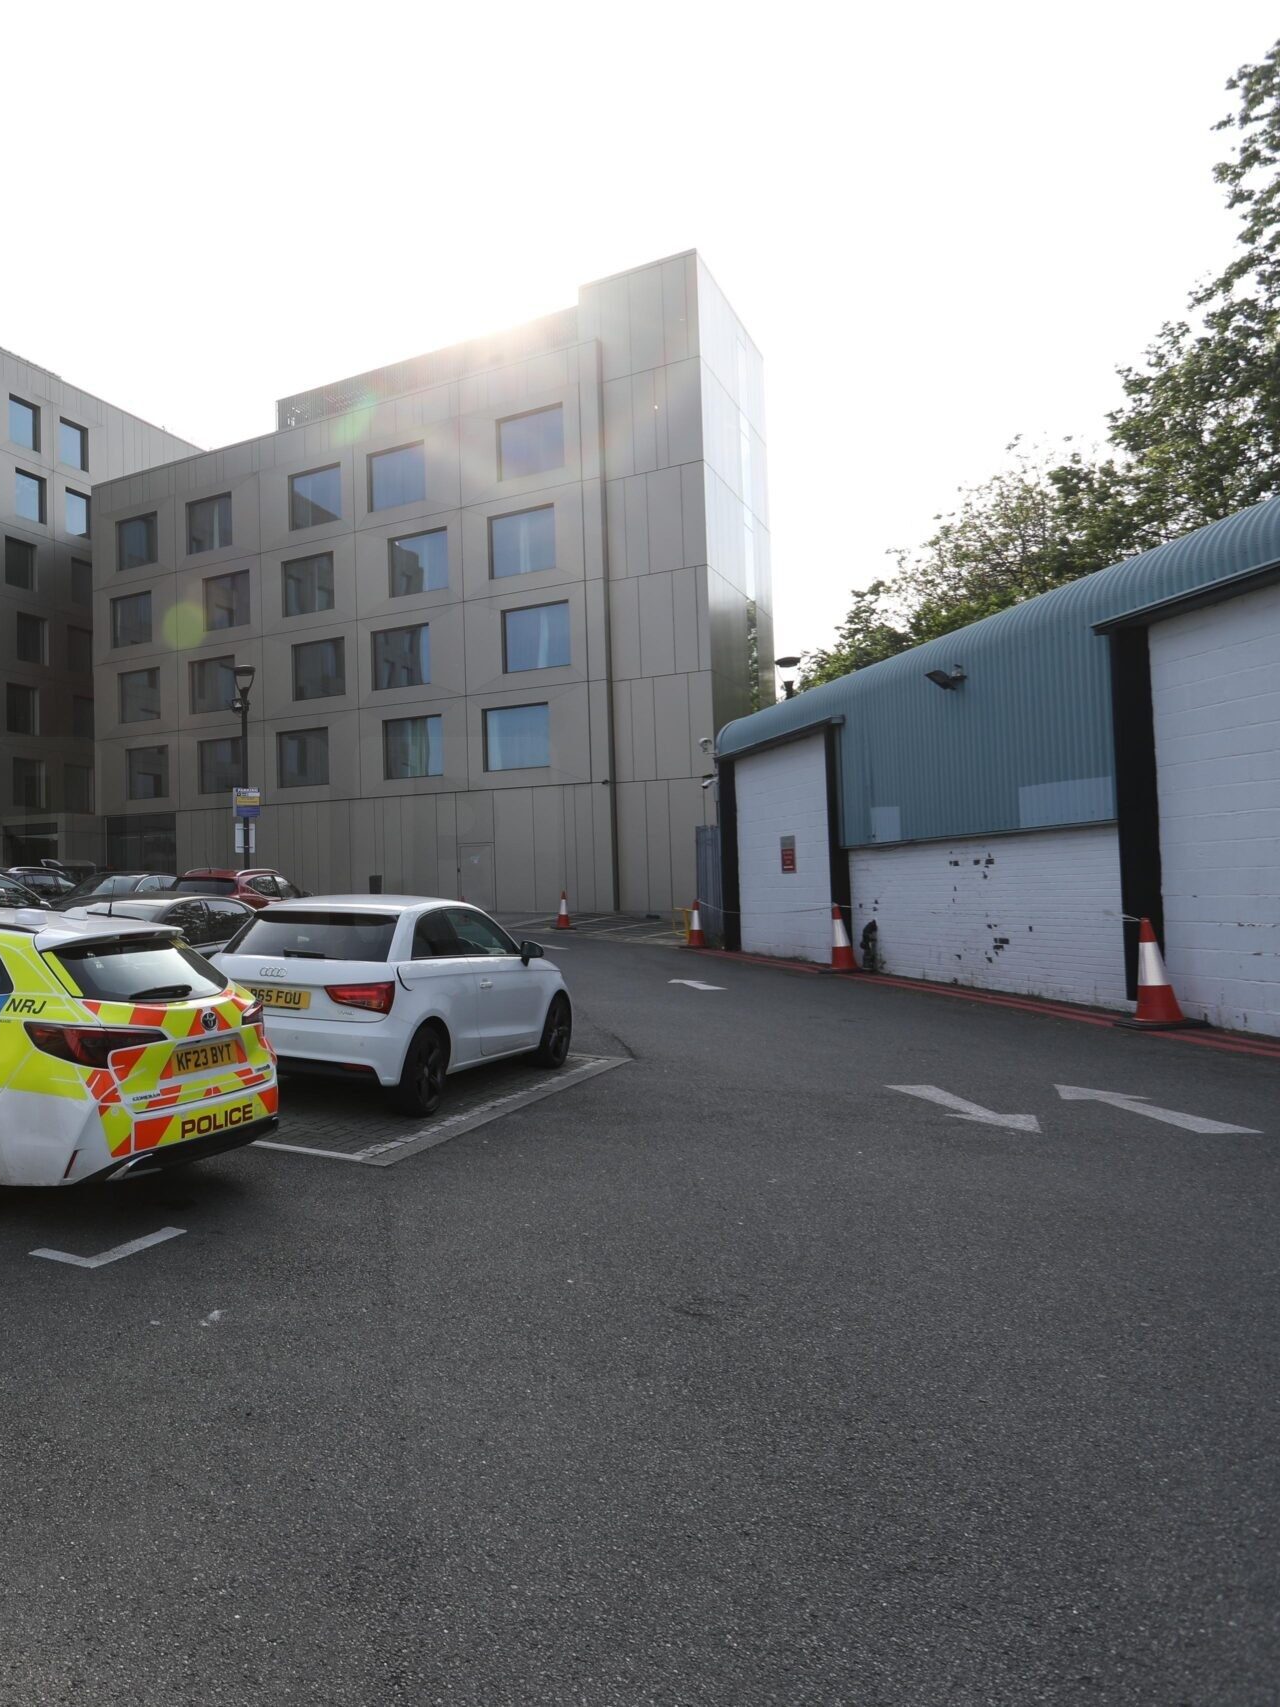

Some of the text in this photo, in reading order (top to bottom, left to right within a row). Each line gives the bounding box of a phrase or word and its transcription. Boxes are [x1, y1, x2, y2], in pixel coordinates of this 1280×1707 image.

[5, 998, 47, 1014] NRJ
[176, 1043, 232, 1072] KF23 BYT
[181, 1103, 253, 1139] POLICE
